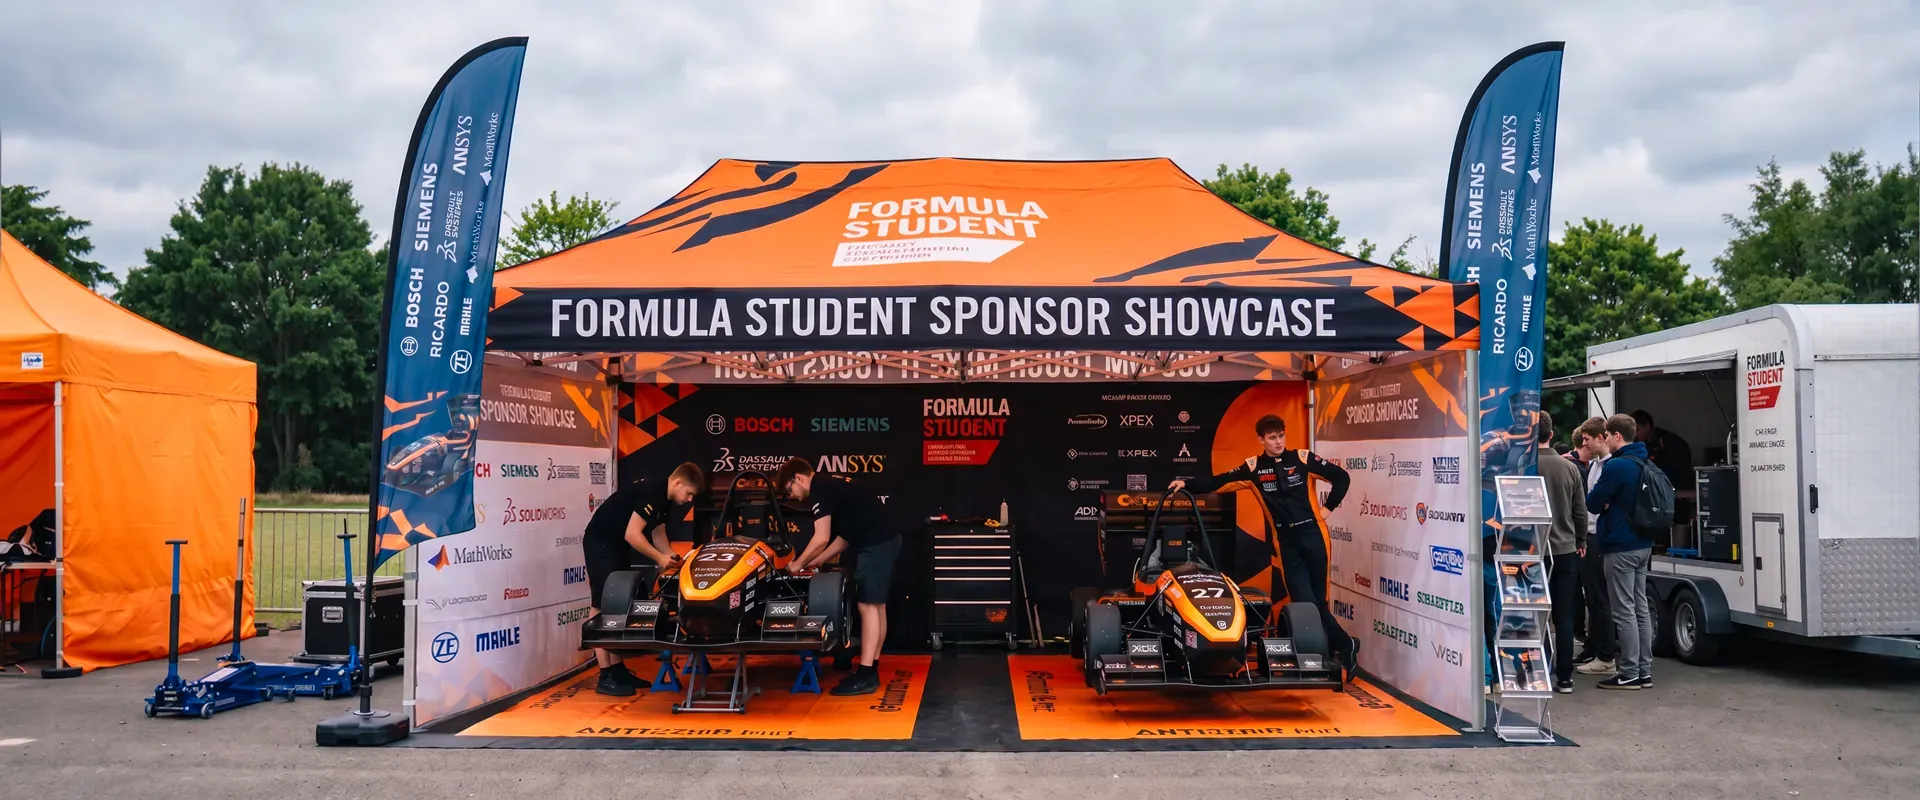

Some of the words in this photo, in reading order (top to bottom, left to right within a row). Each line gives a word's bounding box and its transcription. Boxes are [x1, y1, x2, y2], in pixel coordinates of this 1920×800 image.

[452, 115, 473, 176] ANSYS
[1501, 115, 1517, 174] ANSYS
[415, 162, 438, 251] SIEMENS
[445, 190, 456, 236] DASSAULT
[848, 196, 1049, 219] FORMULA
[1467, 162, 1486, 250] SIEMENS
[1499, 190, 1508, 235] DASSAULT
[842, 216, 1040, 239] STUDENT
[405, 267, 424, 328] BOSCH
[430, 281, 450, 358] RICARDO
[460, 297, 473, 336] MAHLE
[551, 298, 733, 337] FORMULA
[745, 297, 917, 336] STUDENT
[929, 296, 1111, 335] SPONSOR
[1124, 297, 1337, 337] SHOWCASE
[1493, 279, 1507, 354] RICARDO
[1521, 295, 1532, 332] MAHLE
[1747, 350, 1785, 371] FORMULA
[1747, 368, 1784, 387] STUDENT
[480, 399, 529, 424] SPONSOR
[923, 398, 1011, 417] FORMULA
[1375, 398, 1419, 422] SHOWCASE
[734, 417, 794, 432] BOSCH
[810, 417, 890, 432] SIEMENS
[1119, 414, 1154, 426] XPEX
[501, 464, 539, 478] SIEMENS
[816, 455, 884, 473] ANSYS
[454, 544, 513, 564] MathWorks
[698, 553, 735, 562] 23
[564, 566, 586, 585] MAHLE
[1191, 588, 1225, 599] 27
[1380, 576, 1409, 601] MAHLE
[476, 626, 520, 652] MAHLE
